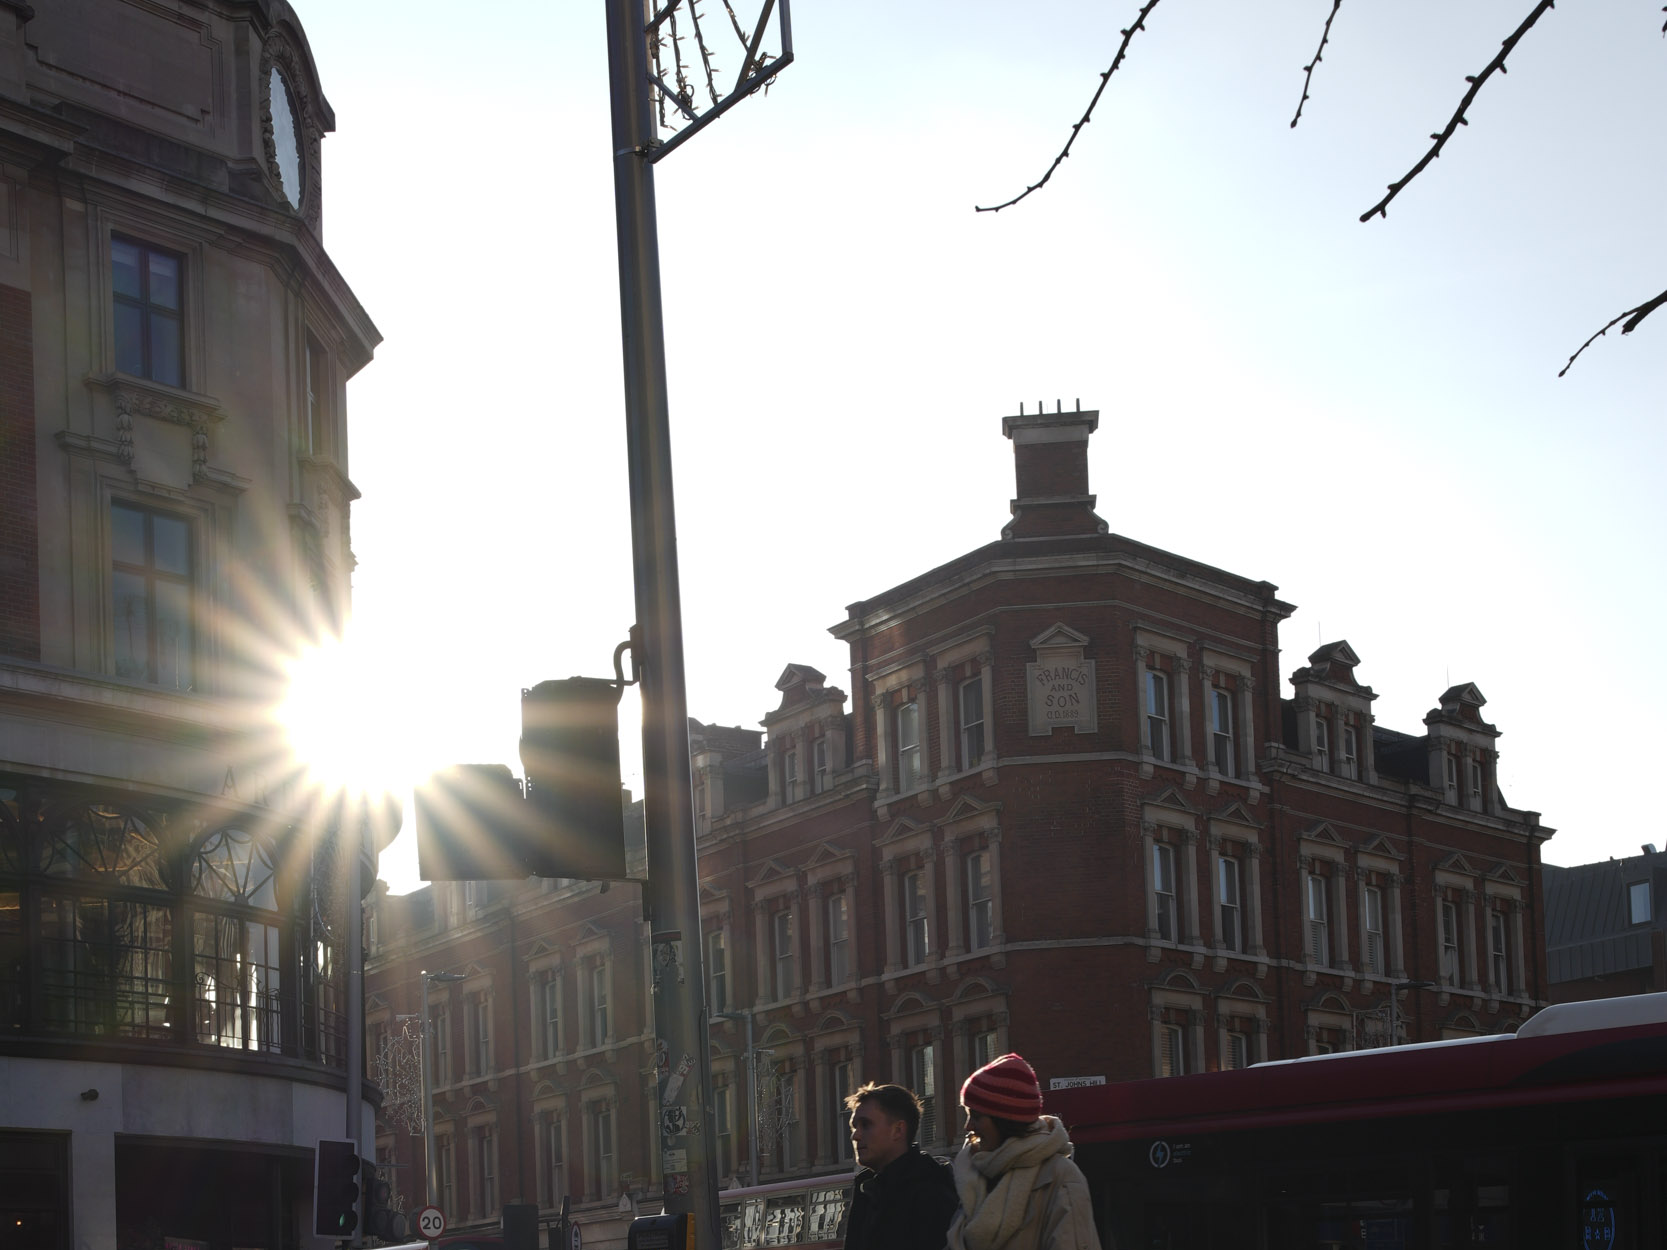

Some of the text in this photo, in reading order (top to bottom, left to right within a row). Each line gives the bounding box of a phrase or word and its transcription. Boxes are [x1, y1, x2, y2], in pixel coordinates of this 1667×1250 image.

[1036, 667, 1088, 686] FRANCIS
[1045, 692, 1081, 707] SON
[422, 1216, 442, 1230] 20
